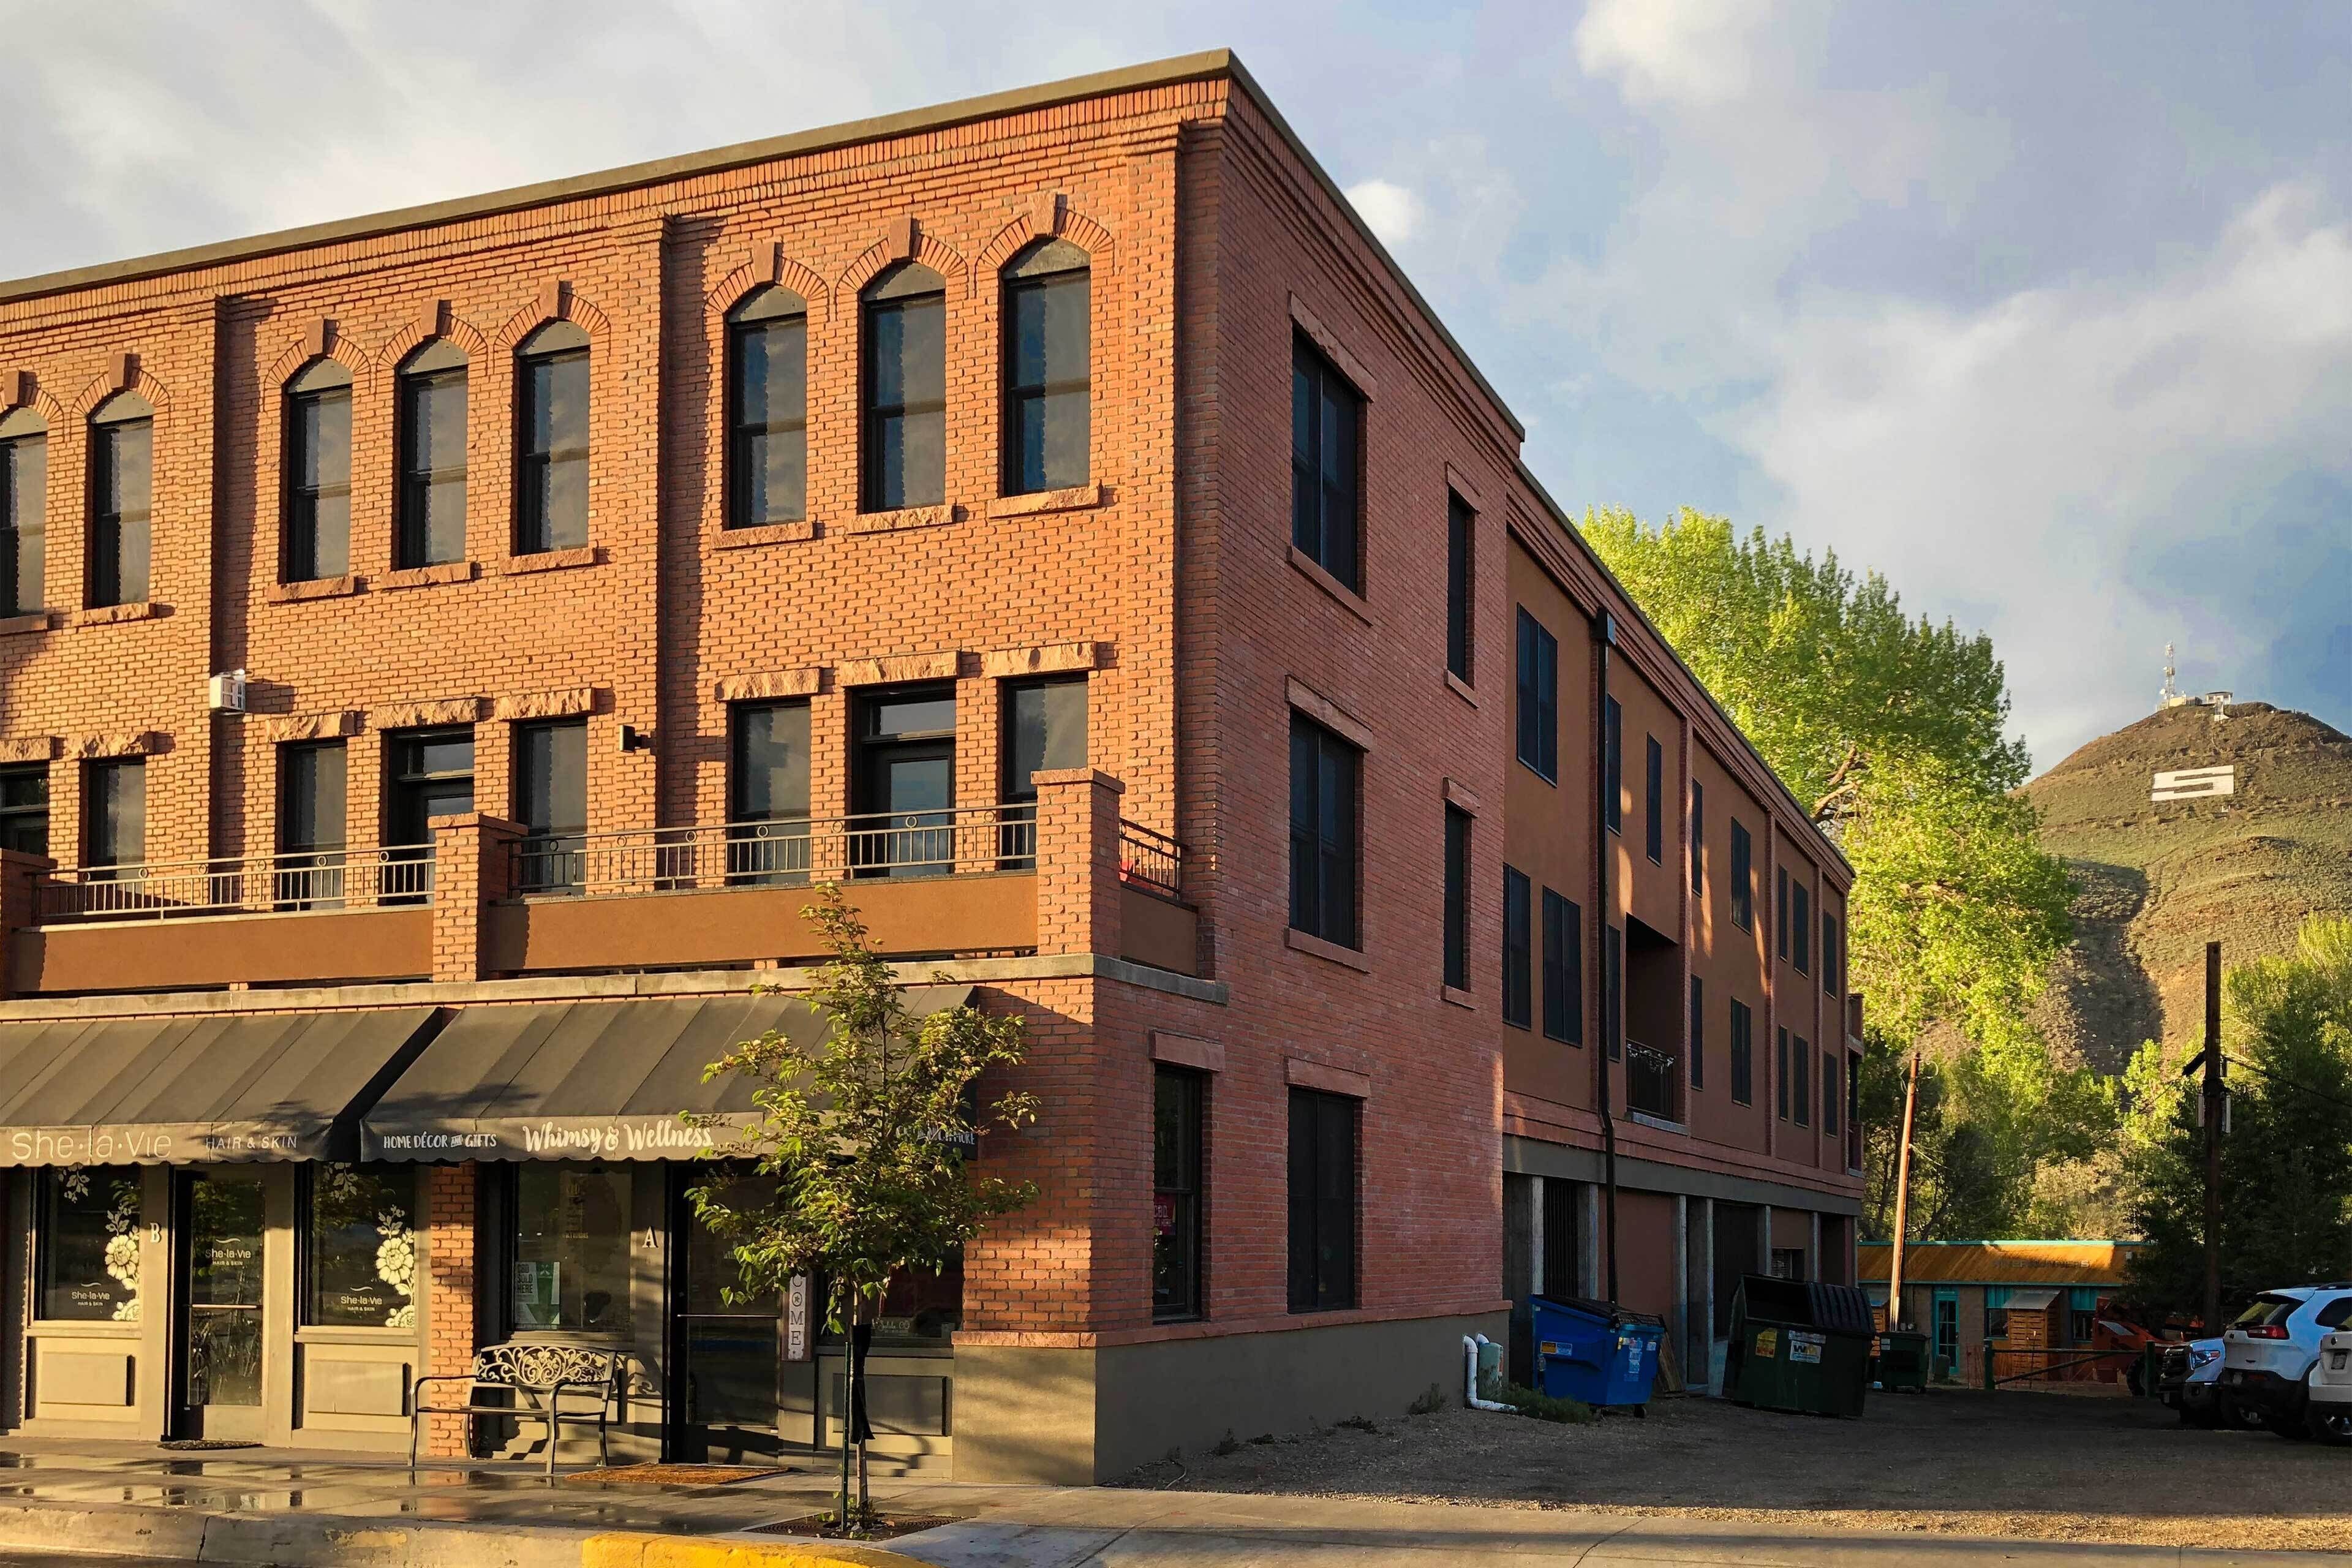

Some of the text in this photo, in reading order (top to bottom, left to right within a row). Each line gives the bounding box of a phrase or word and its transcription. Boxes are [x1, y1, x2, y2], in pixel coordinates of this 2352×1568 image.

[205, 1136, 297, 1150] HAIR & SKIN
[383, 1131, 497, 1148] HOME DÉCOR AND GIFTS
[522, 1120, 714, 1154] Whimsy & Wellness
[149, 1223, 160, 1243] B
[642, 1226, 657, 1248] A
[518, 1274, 533, 1283] SOLD
[518, 1284, 533, 1294] HERE
